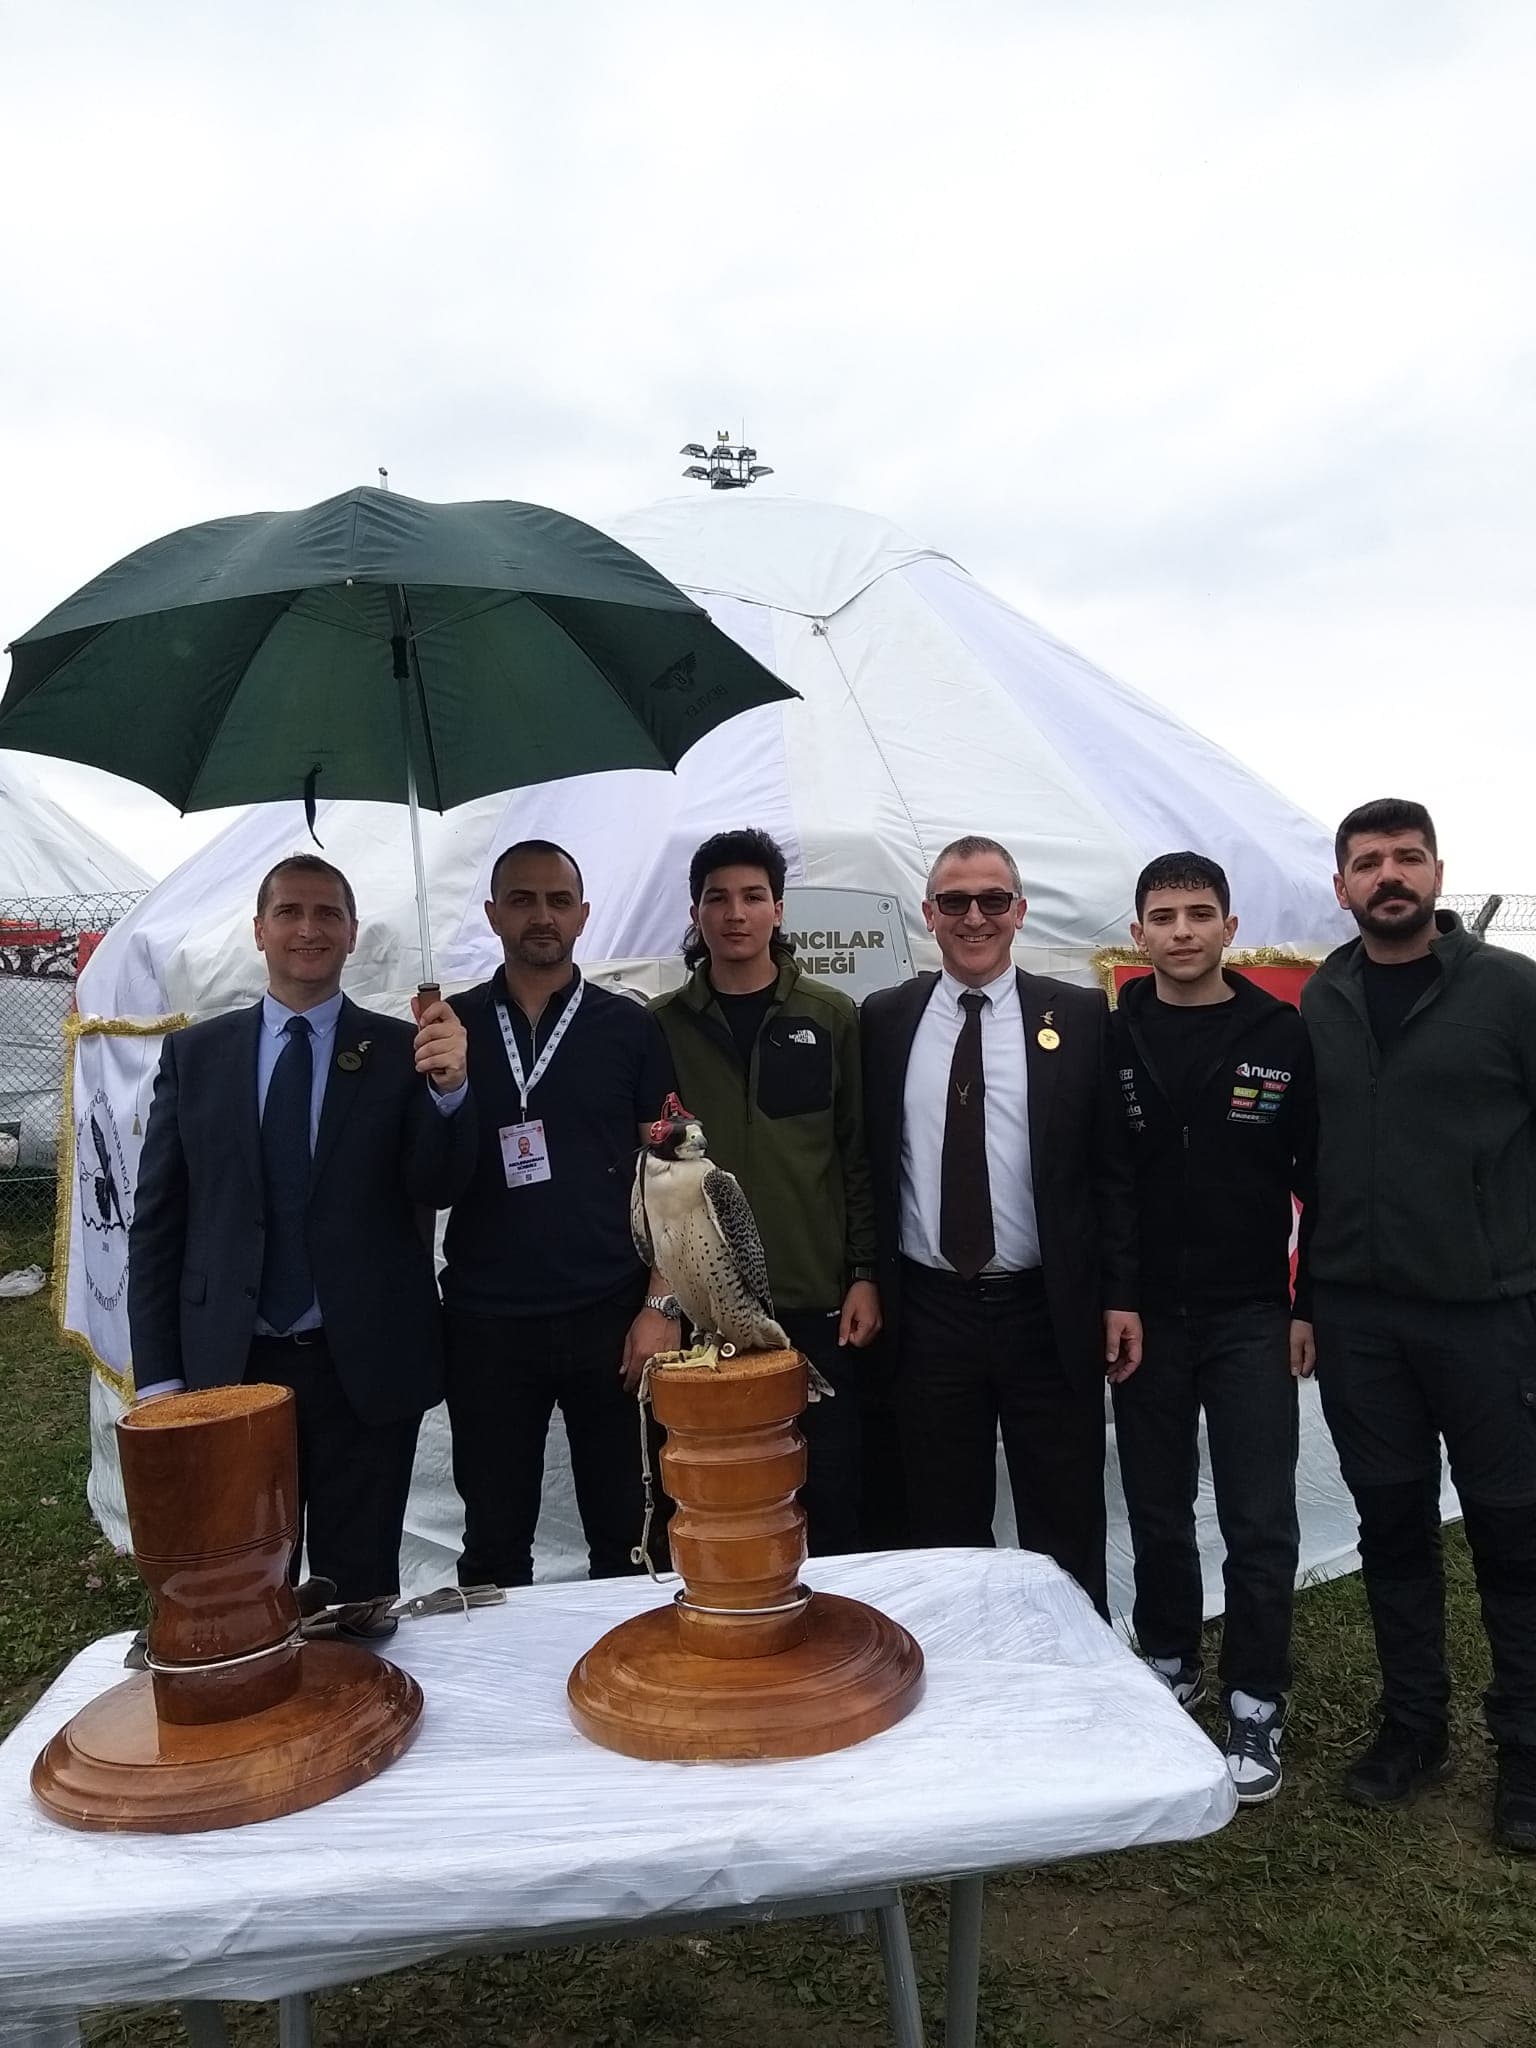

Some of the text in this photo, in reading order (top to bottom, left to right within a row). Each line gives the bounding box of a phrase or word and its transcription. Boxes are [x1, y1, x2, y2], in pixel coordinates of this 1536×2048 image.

[790, 931, 885, 950] NCILAR
[796, 951, 856, 974] NEĞİ
[1251, 1065, 1292, 1082] nukro
